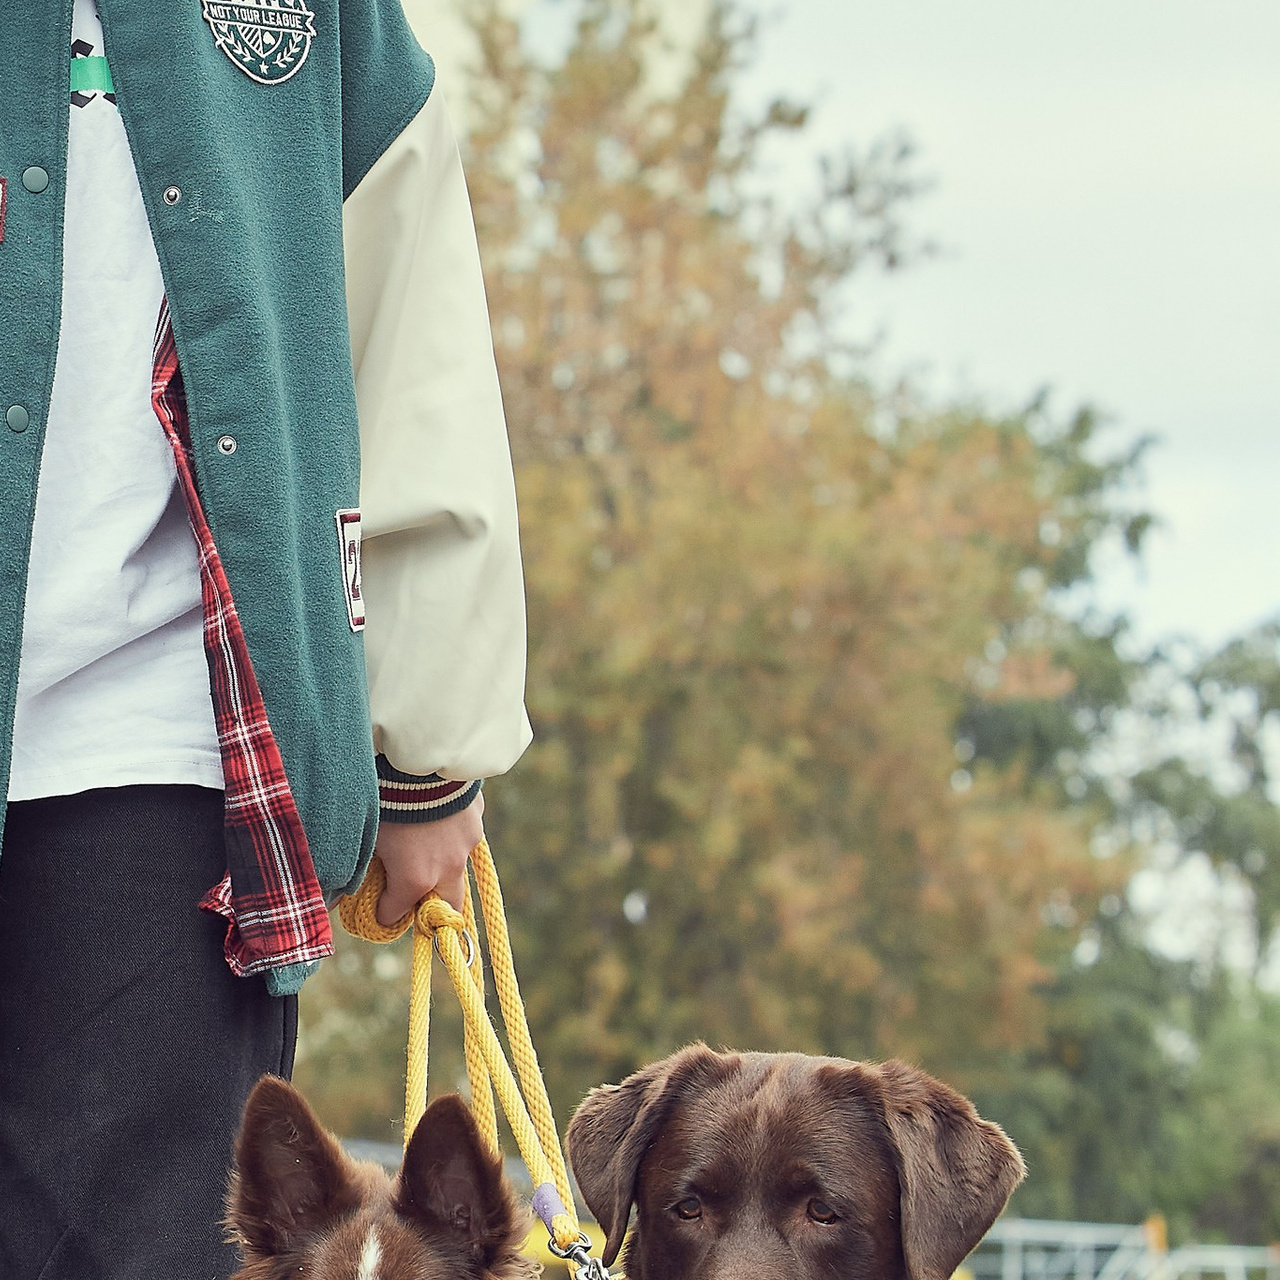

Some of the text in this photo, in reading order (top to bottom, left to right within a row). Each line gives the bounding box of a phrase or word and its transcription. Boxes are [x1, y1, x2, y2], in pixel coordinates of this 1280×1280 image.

[209, 4, 304, 29] NOT YOUR LEAGUE
